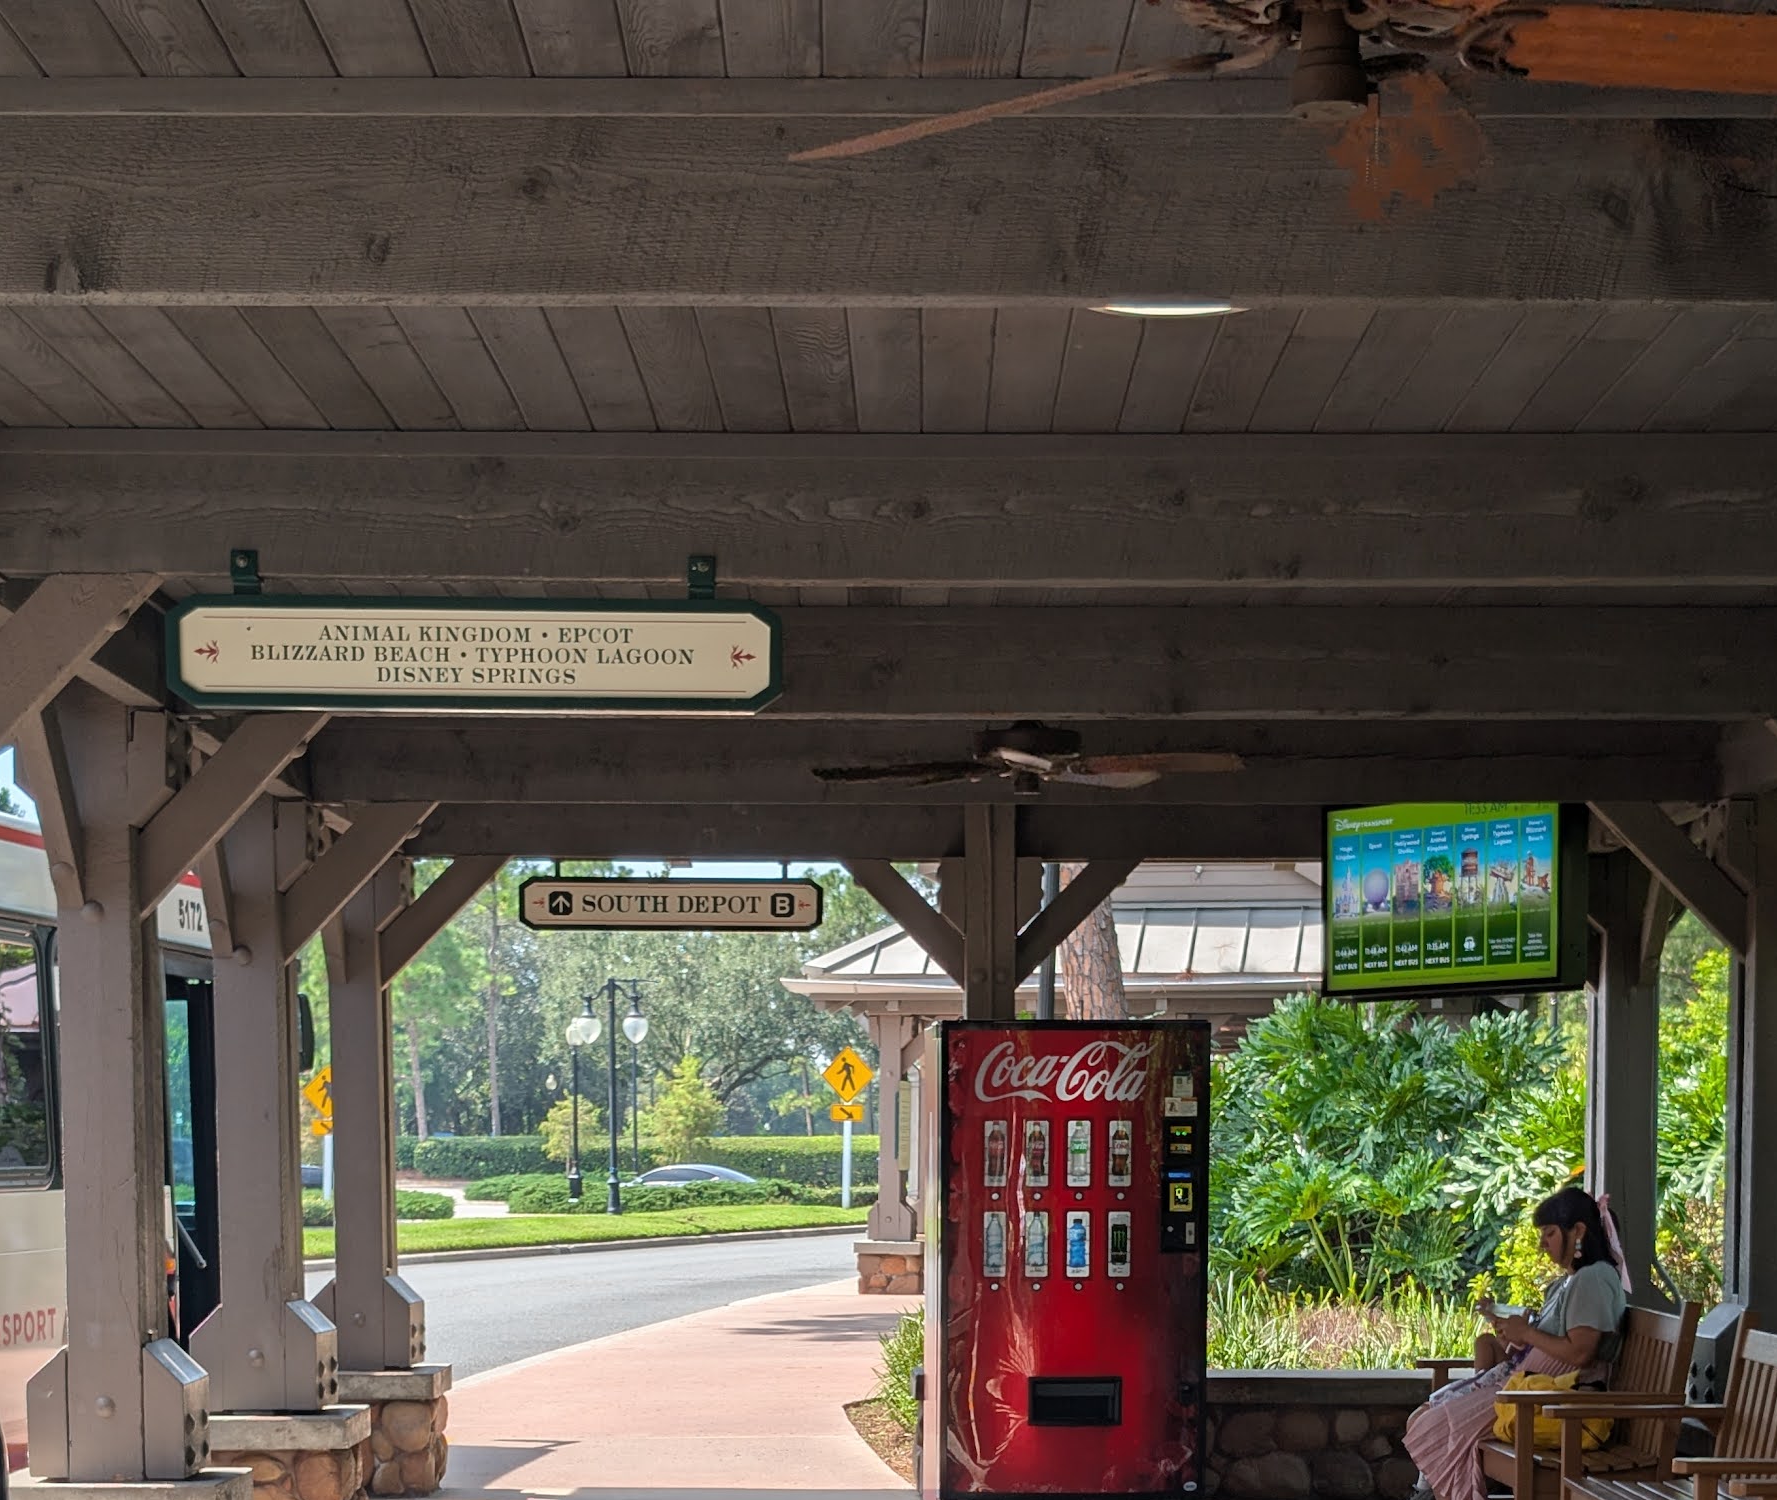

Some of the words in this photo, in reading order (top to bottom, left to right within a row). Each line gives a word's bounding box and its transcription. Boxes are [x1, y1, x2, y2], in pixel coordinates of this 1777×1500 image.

[318, 624, 411, 642] ANIMAL
[419, 626, 531, 643] KINGDOM
[558, 627, 634, 644] EPCOT
[250, 644, 366, 662] BLIZZARD
[374, 646, 450, 663] BEACH
[475, 647, 588, 664] TYPHOON
[596, 648, 695, 665] LAGOON
[377, 667, 464, 683] DISNEY
[472, 667, 577, 685] SPRINGS
[581, 894, 670, 914] SOUTH
[677, 895, 762, 914] DEPOT
[774, 896, 791, 914] B
[178, 899, 204, 932] 5172
[1364, 961, 1377, 969] NEXT
[1425, 957, 1439, 965] NEXT
[1439, 956, 1450, 964] BUS
[974, 1040, 1159, 1103] Coca-Cola
